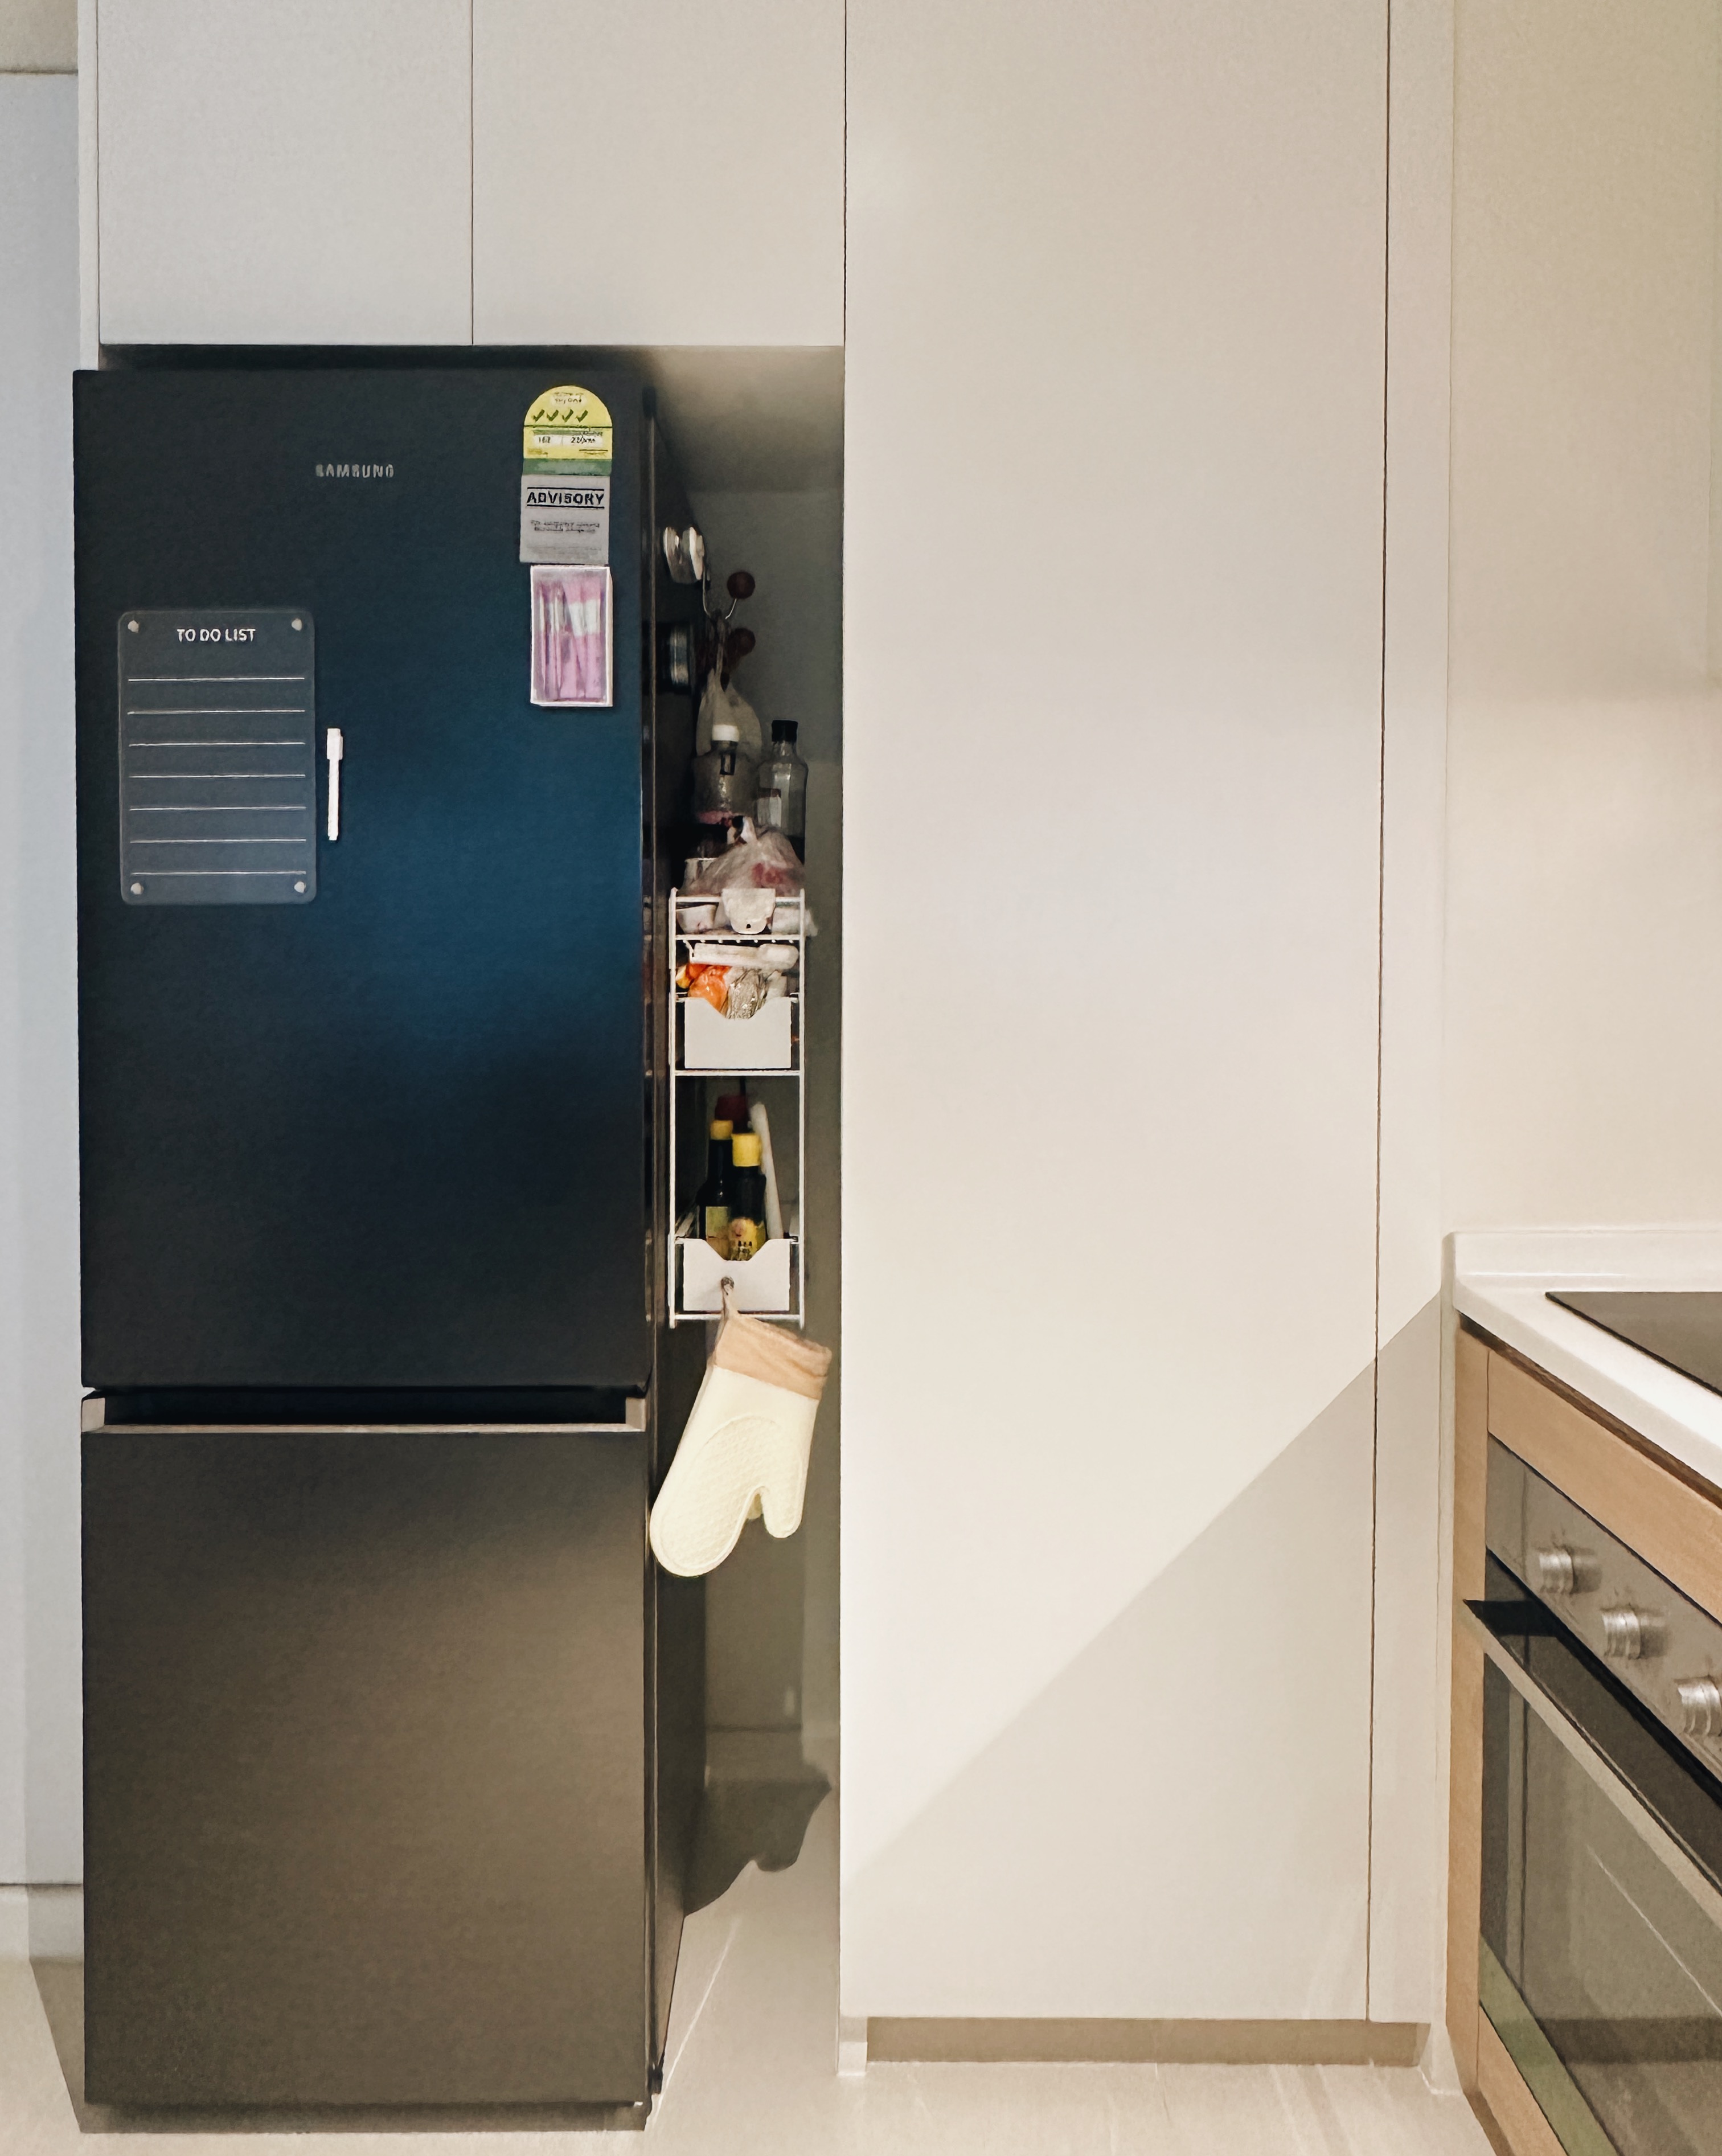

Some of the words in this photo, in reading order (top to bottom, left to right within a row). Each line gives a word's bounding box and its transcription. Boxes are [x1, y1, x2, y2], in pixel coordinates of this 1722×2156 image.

[527, 491, 604, 505] ADVISORY
[177, 629, 196, 642] TO
[200, 629, 220, 642] DO
[225, 629, 256, 642] LIST
